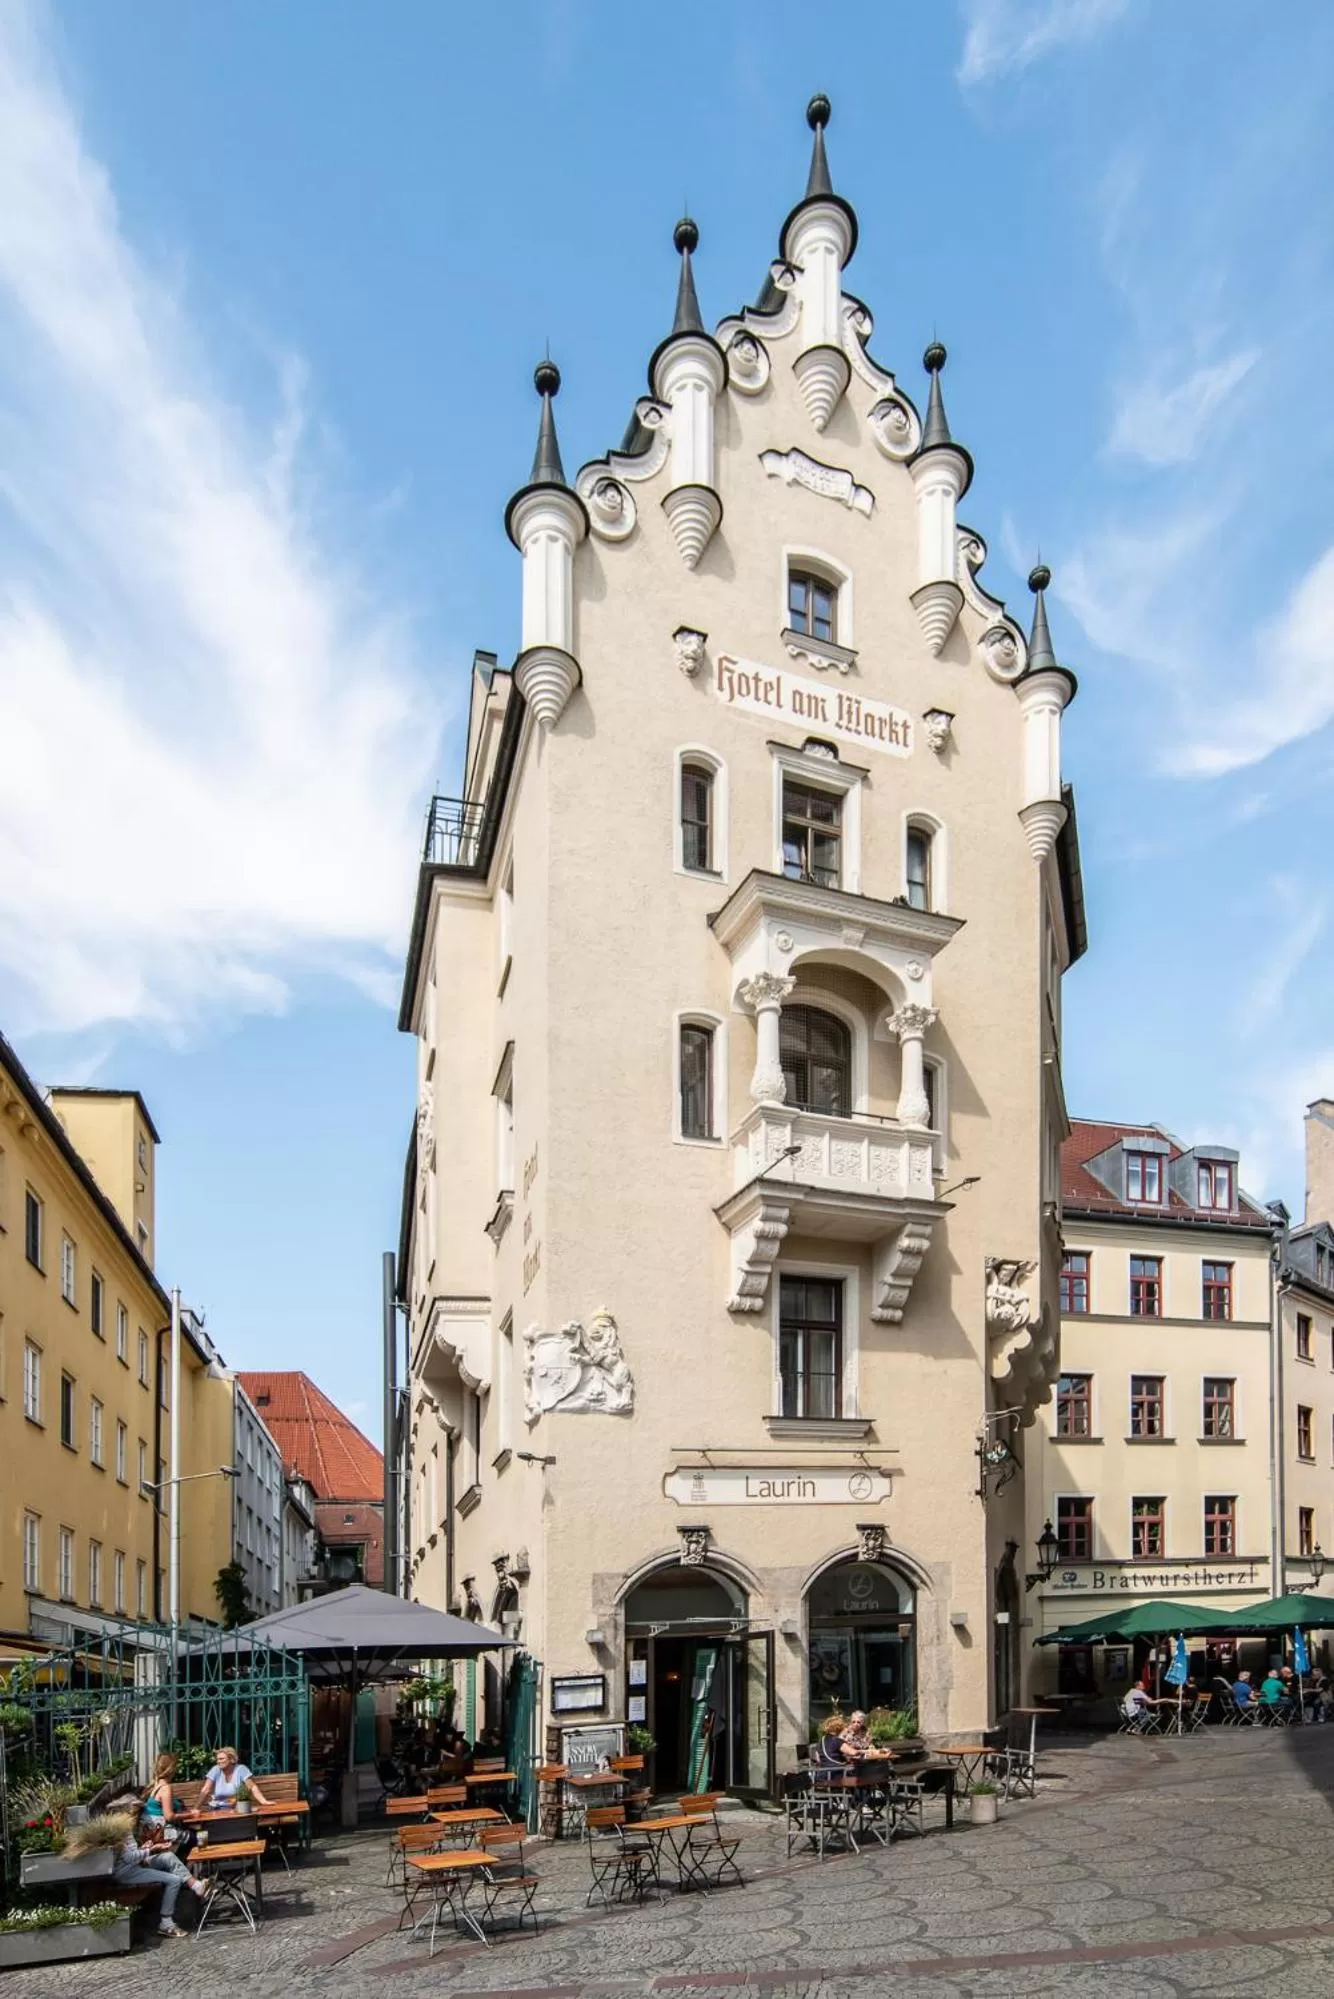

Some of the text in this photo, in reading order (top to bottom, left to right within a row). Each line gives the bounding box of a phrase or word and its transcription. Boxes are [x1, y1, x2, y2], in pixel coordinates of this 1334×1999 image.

[717, 655, 911, 748] Hotel am Markt
[745, 1475, 816, 1498] Laurin
[1092, 1565, 1255, 1590] Bratwurstherzl
[843, 1598, 879, 1610] Laurin
